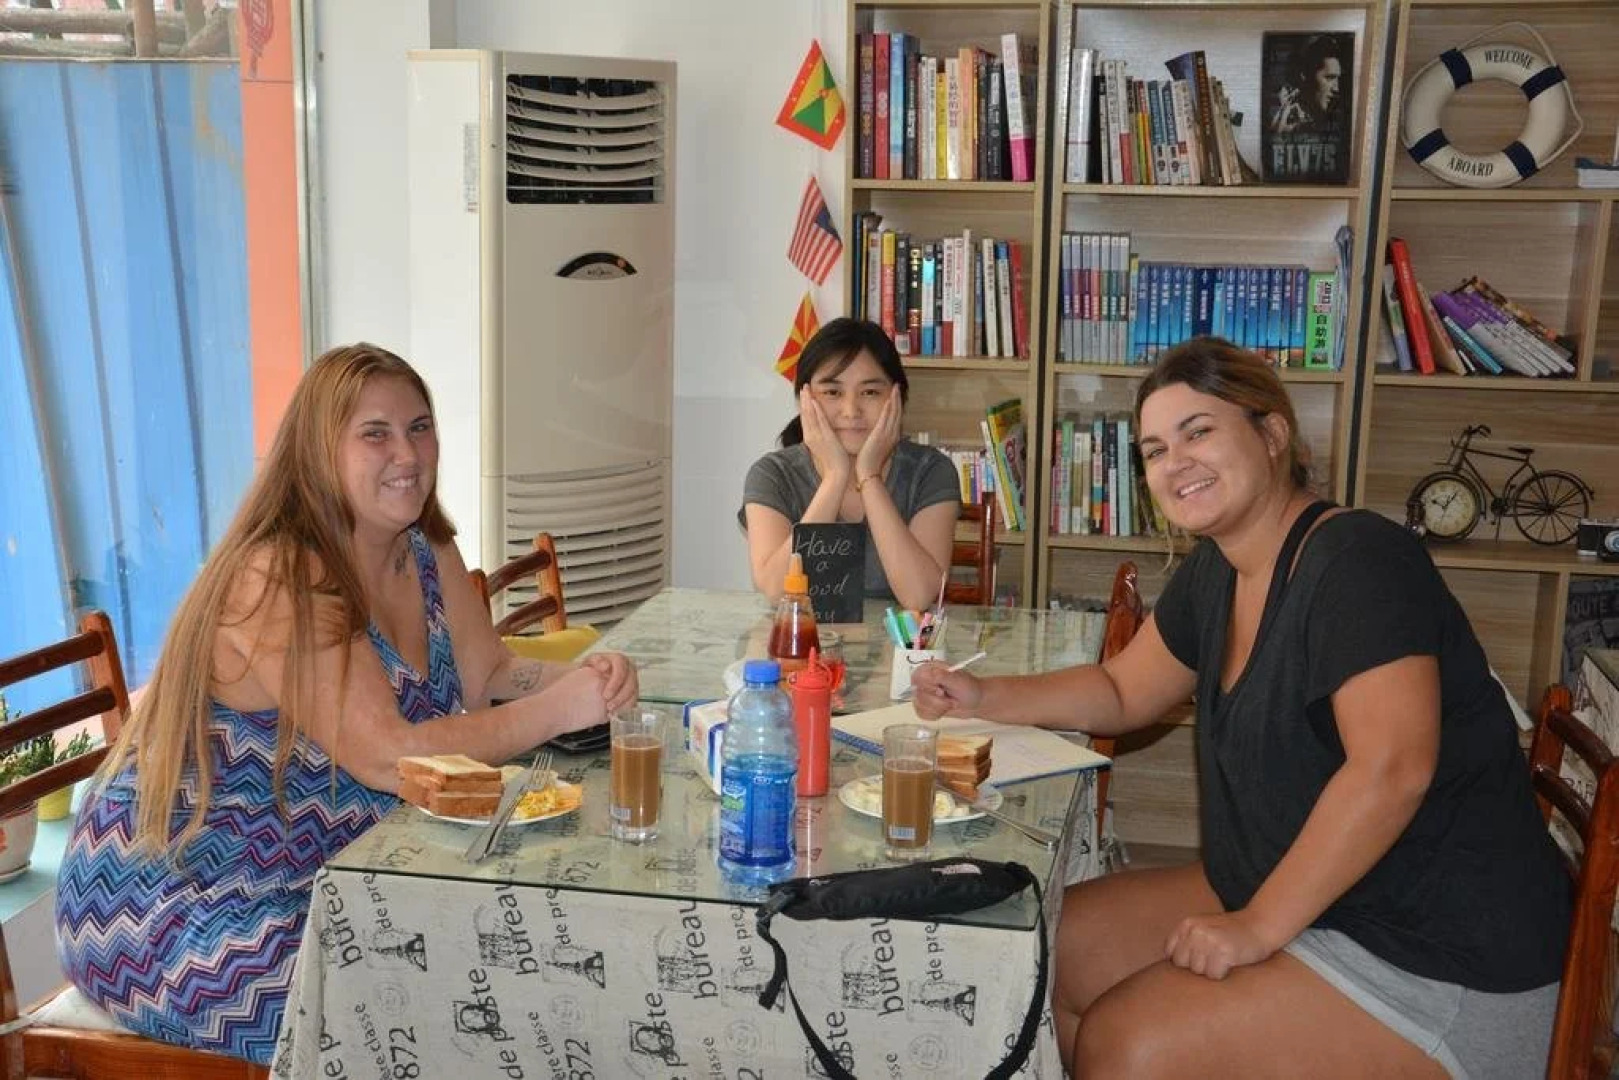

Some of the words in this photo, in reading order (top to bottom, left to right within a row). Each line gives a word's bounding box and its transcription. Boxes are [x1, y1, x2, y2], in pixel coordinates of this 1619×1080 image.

[1484, 50, 1534, 70] WELCOME
[1447, 157, 1494, 177] ABOARD
[794, 531, 853, 557] Have
[816, 560, 831, 573] a
[809, 573, 849, 596] ood
[375, 906, 393, 931] de
[555, 924, 571, 945] de
[738, 946, 755, 968] de
[926, 958, 944, 981] de
[499, 1049, 525, 1080] de
